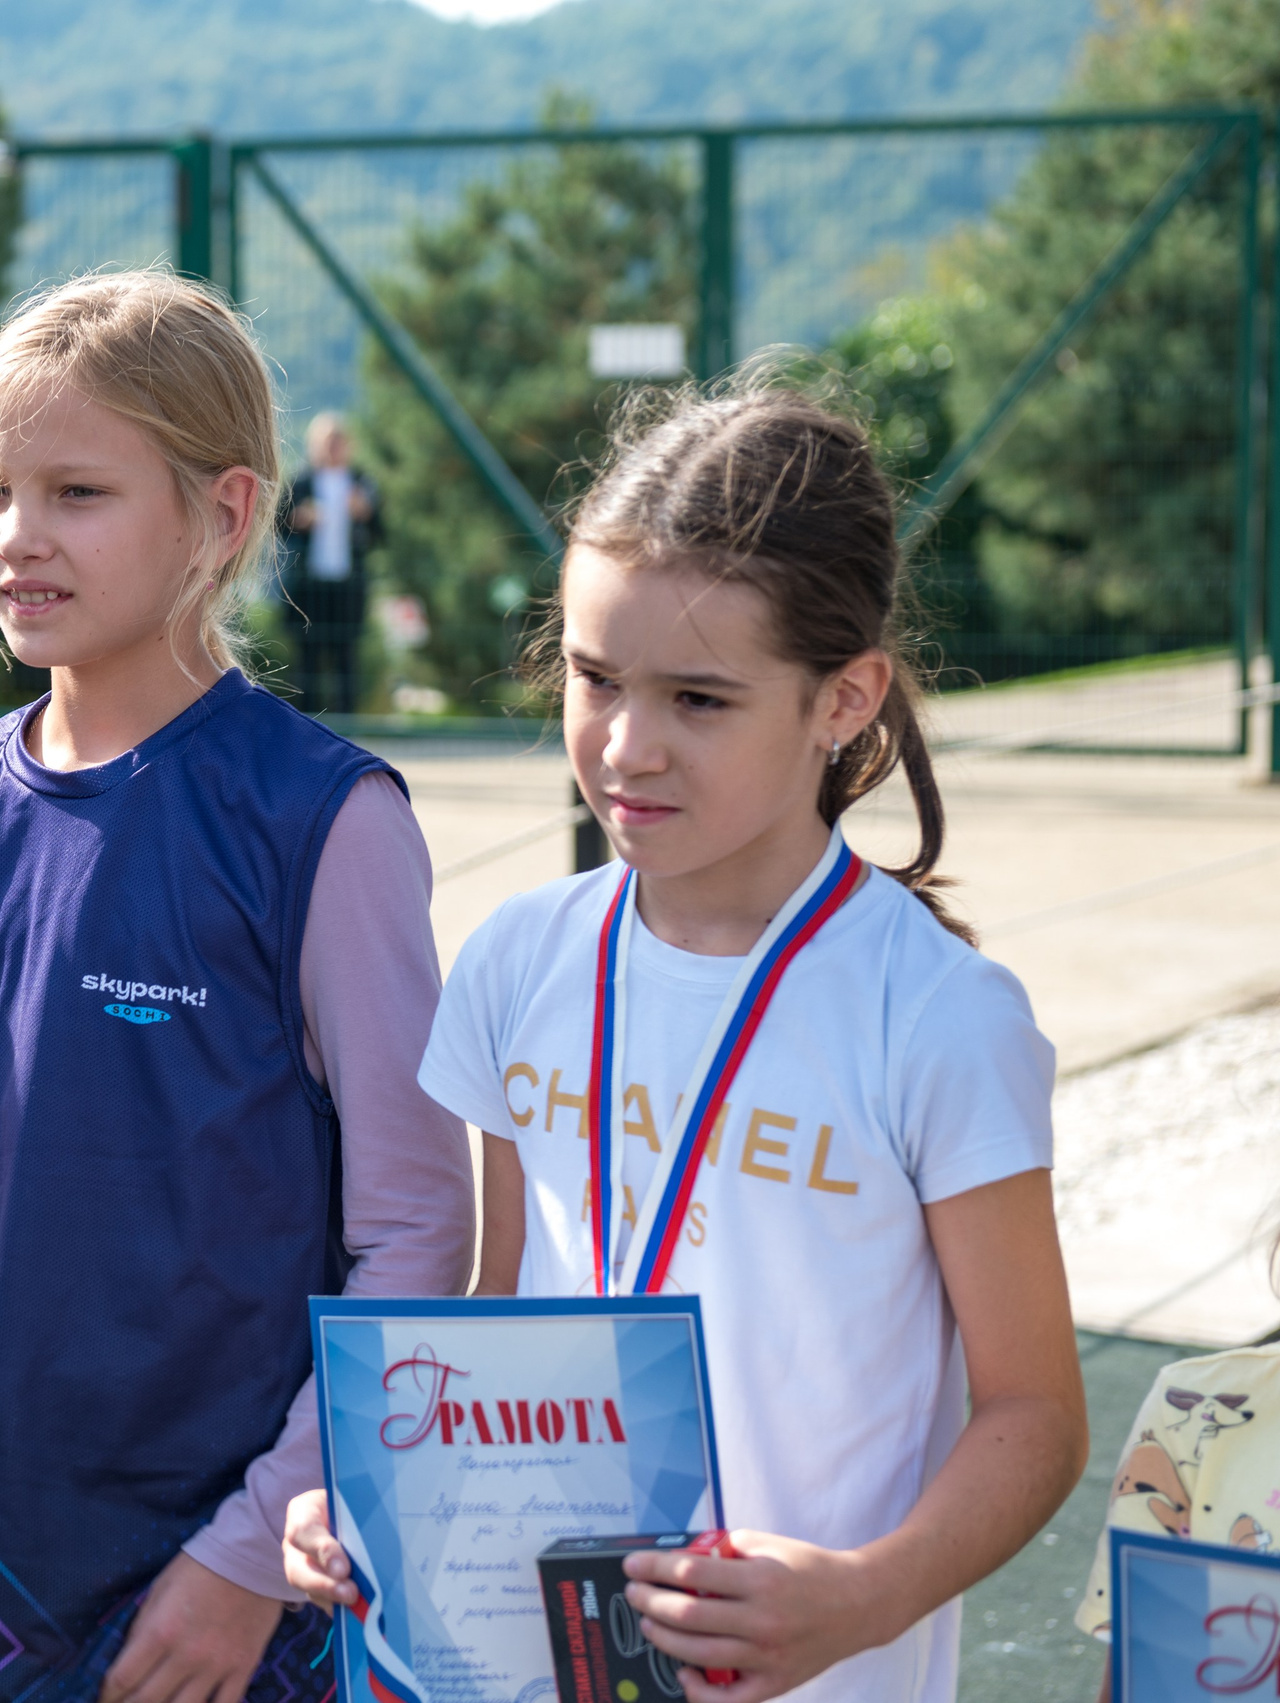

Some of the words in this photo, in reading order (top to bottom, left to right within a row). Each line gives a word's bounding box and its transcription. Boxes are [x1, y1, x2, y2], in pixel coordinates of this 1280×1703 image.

[81, 972, 207, 1008] skypark!
[113, 1005, 168, 1021] SOCHI
[557, 1580, 587, 1655] СКЛАДНОЙ
